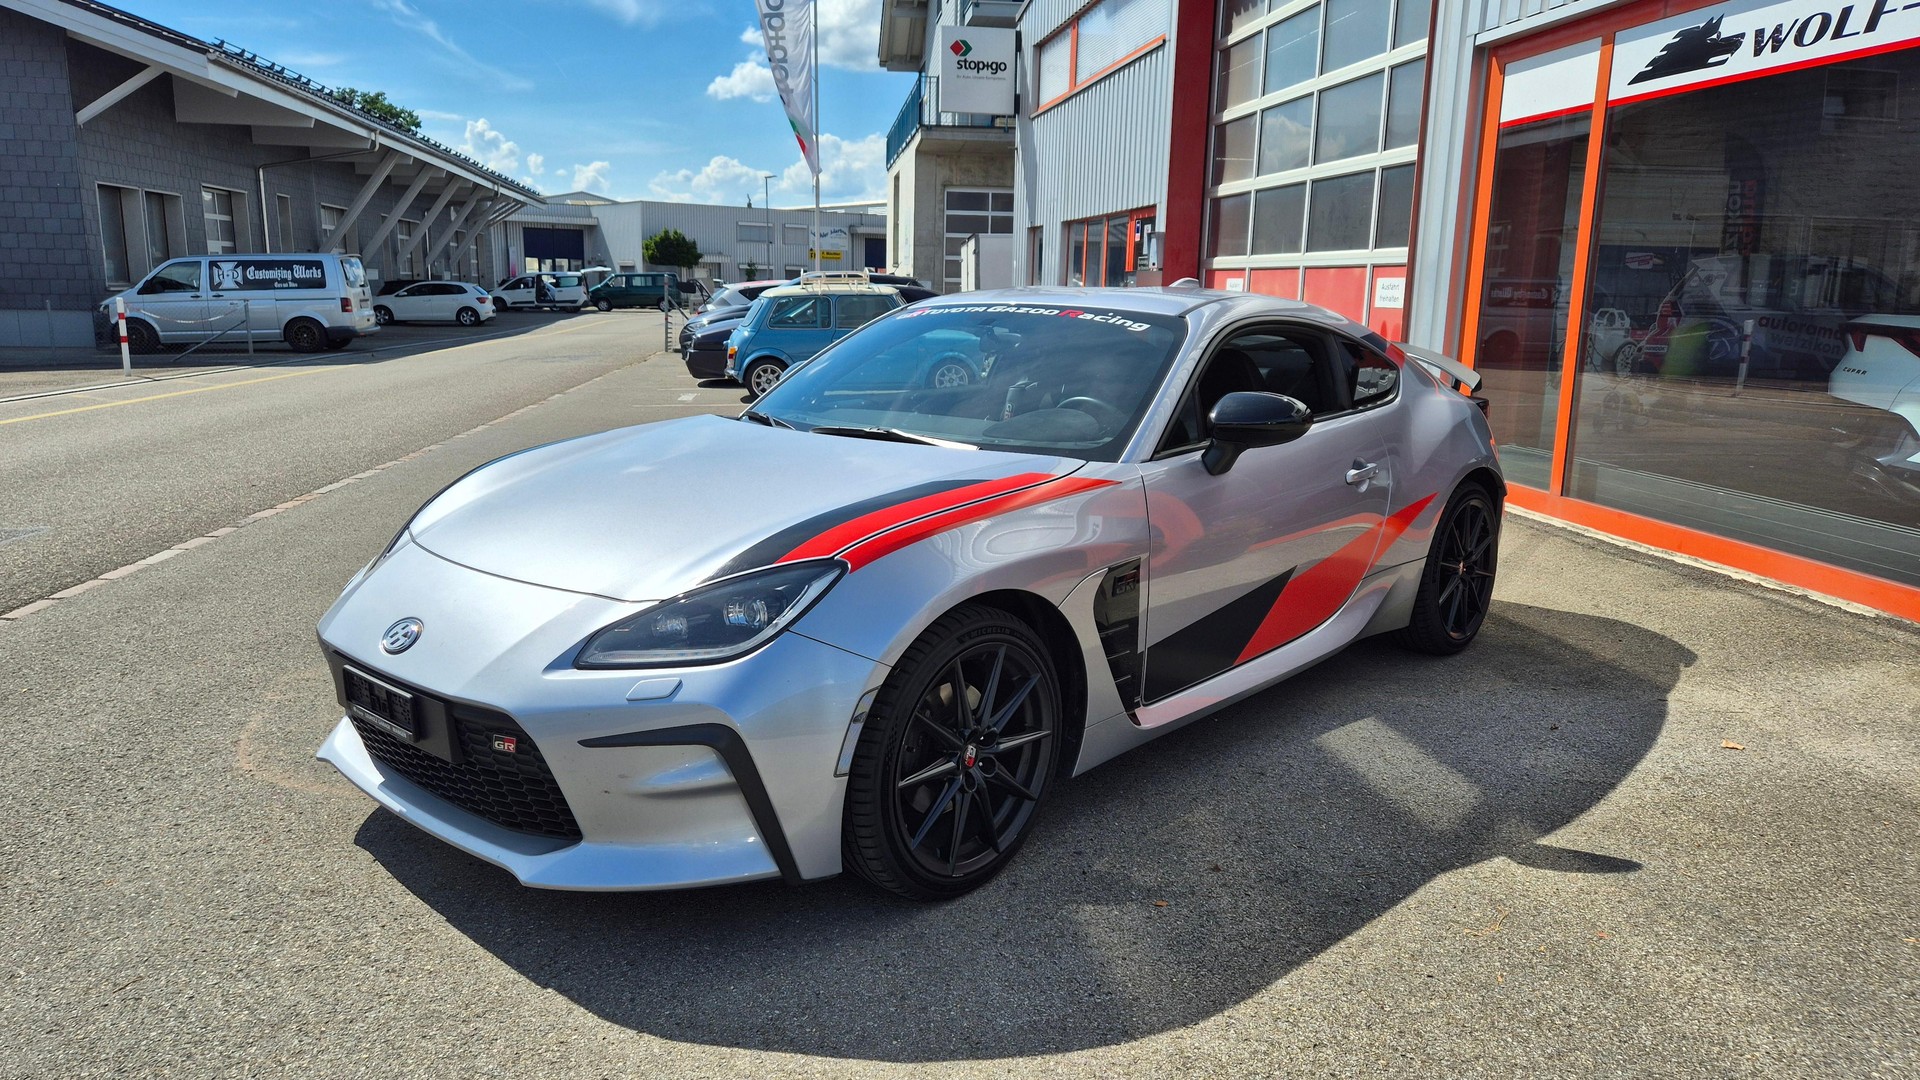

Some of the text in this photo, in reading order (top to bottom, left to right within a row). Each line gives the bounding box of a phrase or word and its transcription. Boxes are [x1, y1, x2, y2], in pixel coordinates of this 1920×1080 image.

[956, 58, 1007, 75] stop+go
[246, 264, 322, 281] Customizing Works
[921, 306, 988, 316] TOYOTA
[987, 305, 1060, 316] GAZOO
[1058, 308, 1152, 332] Racing
[494, 741, 516, 752] GR
